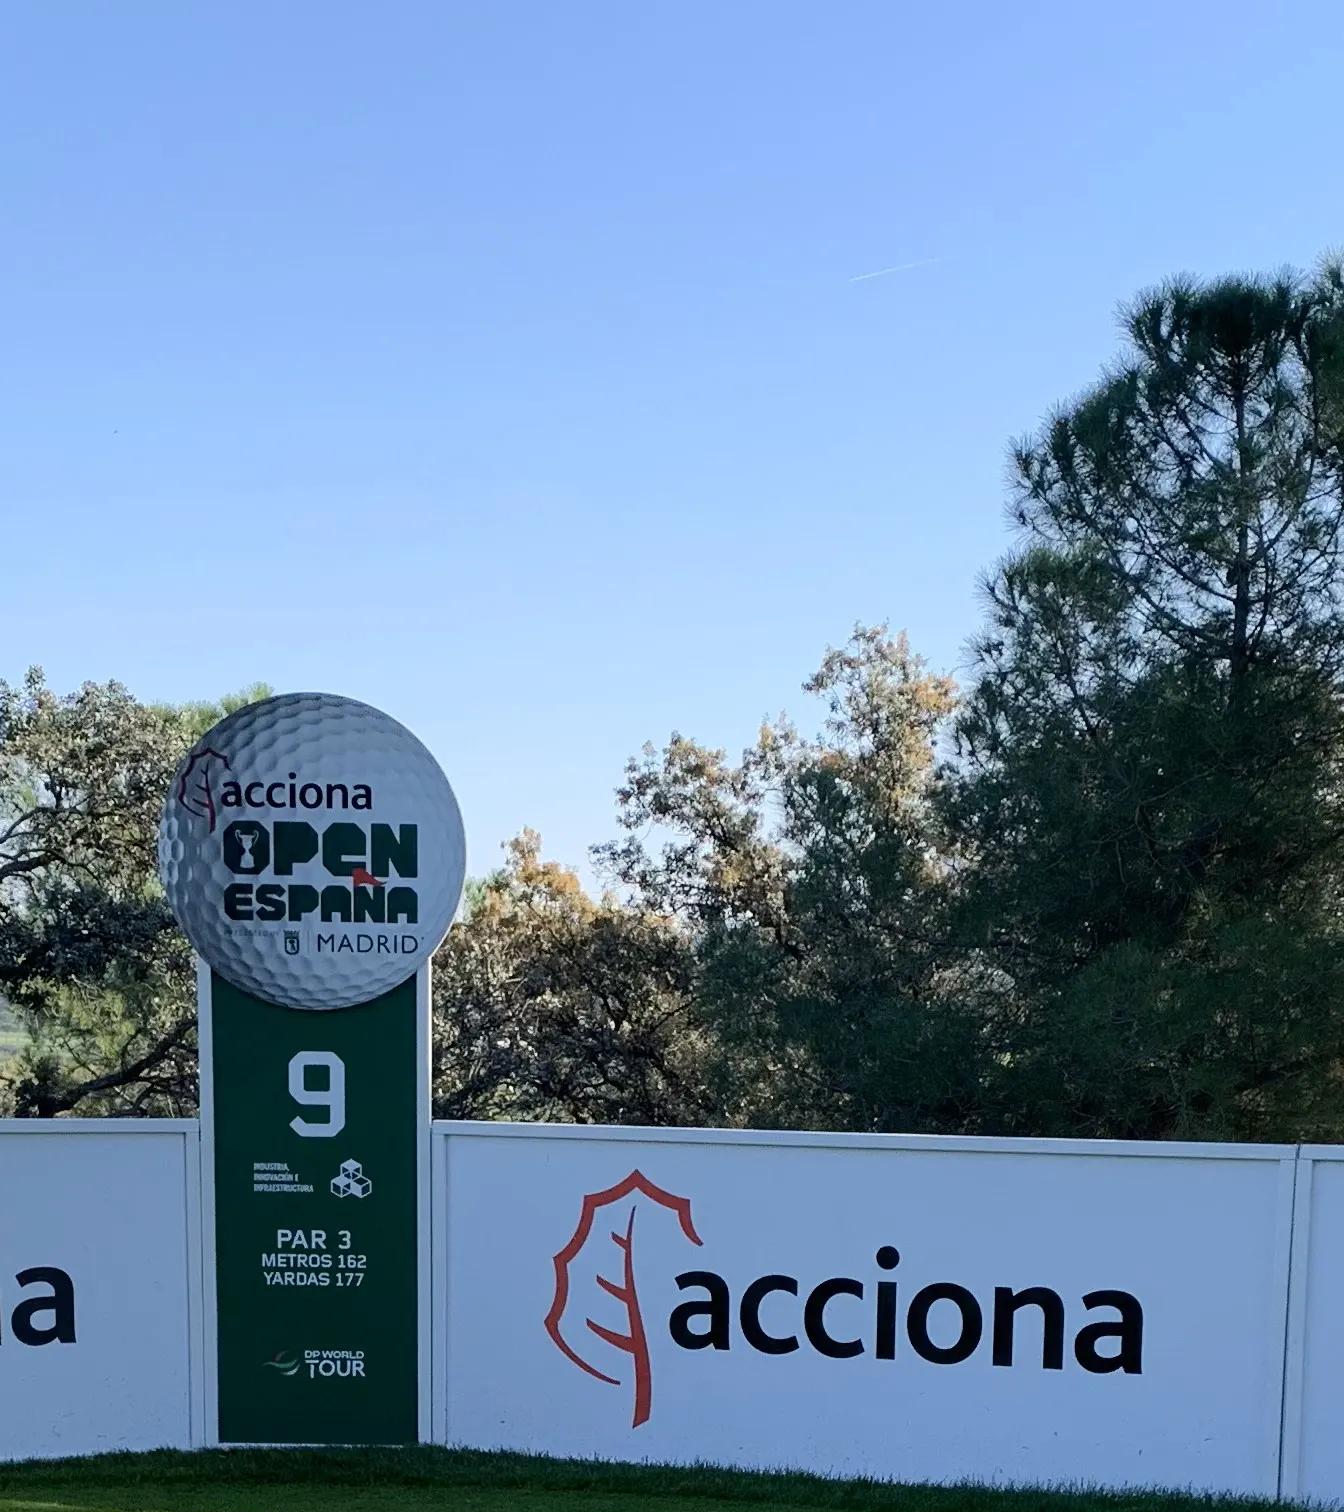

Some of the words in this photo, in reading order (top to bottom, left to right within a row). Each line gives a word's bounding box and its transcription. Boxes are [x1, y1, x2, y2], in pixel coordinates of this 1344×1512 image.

[221, 772, 372, 810] acciona
[223, 820, 418, 878] OPEN
[223, 868, 418, 924] ESPAÑA
[317, 933, 418, 954] MADRID
[288, 1050, 346, 1138] 9
[276, 1229, 327, 1249] PAR
[338, 1230, 351, 1250] 3
[261, 1253, 333, 1268] METROS
[338, 1254, 367, 1269] 162
[263, 1271, 330, 1286] YARDAS
[336, 1273, 365, 1287] 177
[668, 1245, 1144, 1376] acciona
[305, 1350, 320, 1359] DP
[322, 1350, 365, 1360] WORLD
[305, 1360, 366, 1379] TOUR
